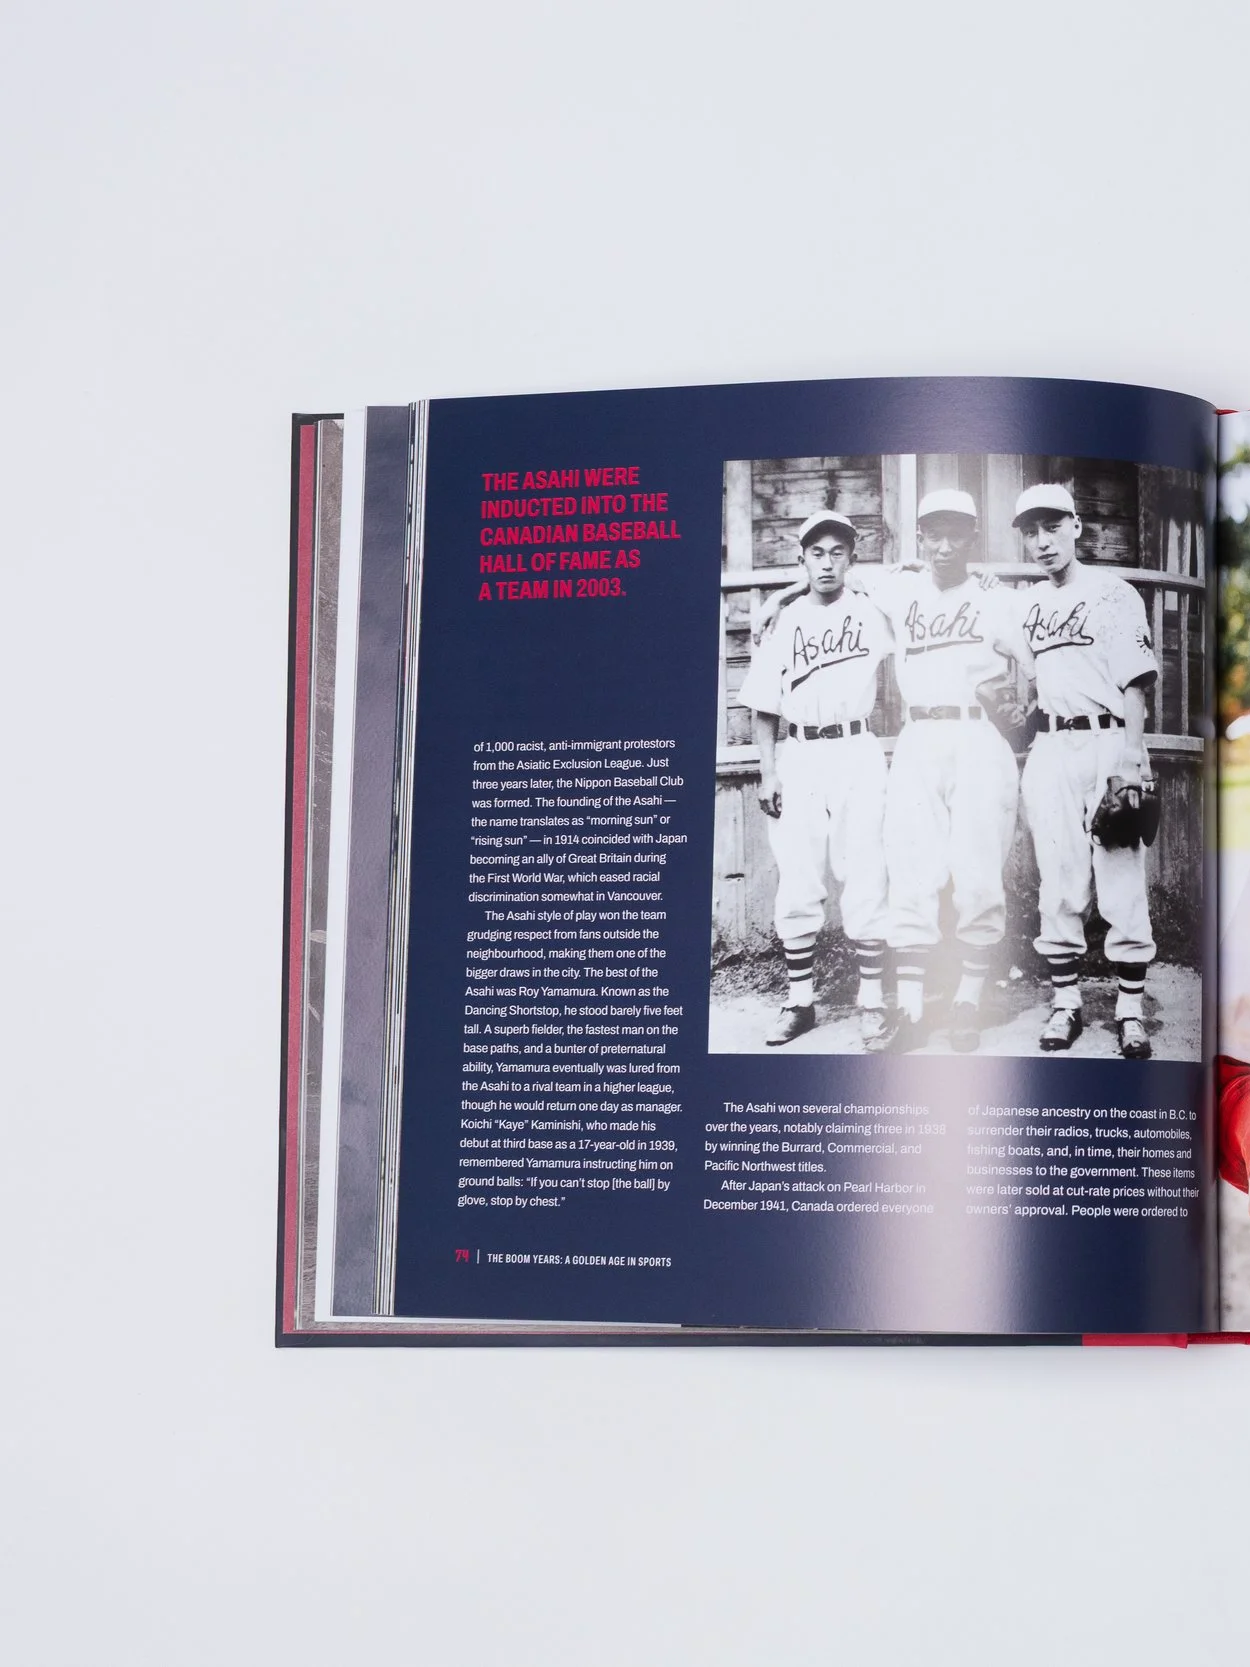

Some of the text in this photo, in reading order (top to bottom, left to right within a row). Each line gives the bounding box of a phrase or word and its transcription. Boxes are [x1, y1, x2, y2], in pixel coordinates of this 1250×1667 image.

[483, 468, 638, 490] THE ASAHI WERE
[482, 494, 667, 518] INDUCTED INTO THE
[481, 521, 680, 546] CANADIAN BASEBALL
[481, 550, 640, 572] HALL OF FAME AS
[480, 579, 625, 600] A TEAM IN 2003.
[905, 600, 983, 643] Asahi
[1023, 600, 1094, 645] Asahi
[793, 615, 870, 670] Asahi
[474, 739, 676, 753] of 1,000 racist, anti-immigrant protestors
[473, 758, 669, 771] from the Asiatic Exclusion League. Just
[472, 776, 684, 791] three years later, the Nippon Baseball Club
[468, 890, 663, 902] discrimination somewhat in Vancouver.
[466, 947, 666, 961] neighbourhood, making them one of the
[723, 1102, 929, 1116] The Asahi won several championships
[968, 1104, 1196, 1120] of Japanese ancestry on the coast in B.C. to
[968, 1125, 1192, 1140] surrender their radios, trucks, automobiles,
[705, 1140, 922, 1154] by winning the Burrard, Commercial, and
[459, 1157, 673, 1172] remembered Yamamura instructing him on
[704, 1160, 826, 1172] Pacific Northwest titles.
[704, 1199, 934, 1215] December 1941, Canada ordered everyone
[456, 1249, 469, 1263] 74
[487, 1253, 672, 1267] THE BOOM YEARS: A GOLDEN AGE IN SPORTS
